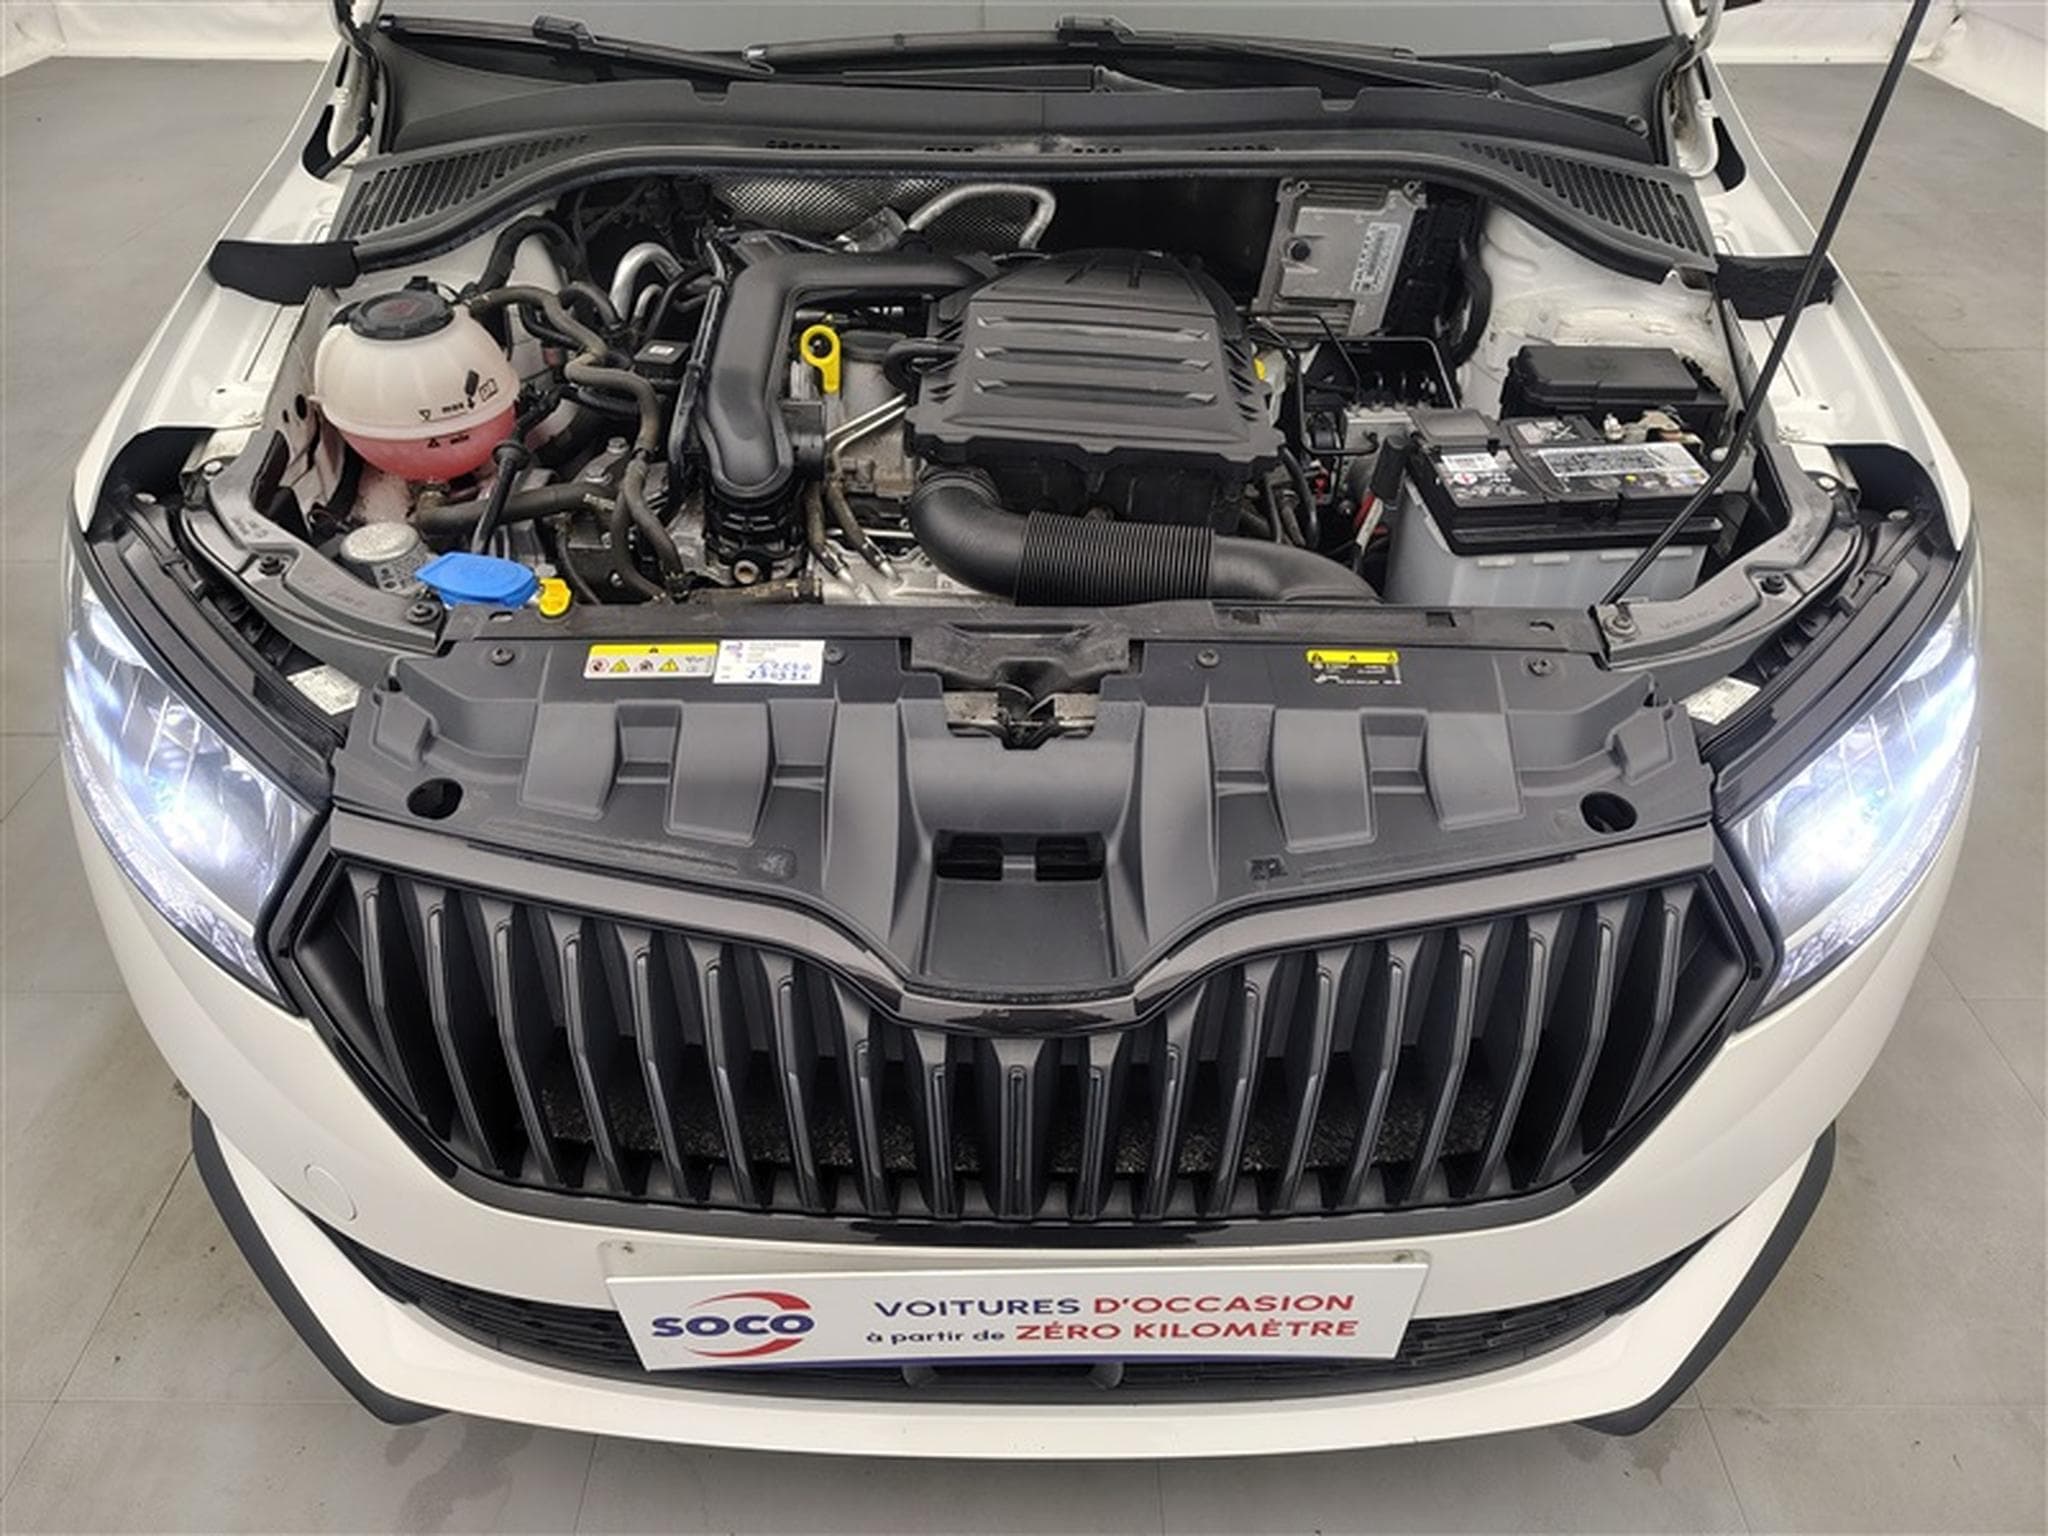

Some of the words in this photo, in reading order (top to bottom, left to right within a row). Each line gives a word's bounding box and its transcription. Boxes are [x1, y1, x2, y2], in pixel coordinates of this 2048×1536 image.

[875, 1298, 1081, 1317] VOITURES
[1094, 1294, 1355, 1314] D'OCCASION
[652, 1314, 815, 1337] SOCO
[866, 1329, 883, 1343] à
[890, 1329, 965, 1345] partir
[972, 1329, 1005, 1342] de
[1016, 1320, 1121, 1340] ZÉRO
[1133, 1318, 1360, 1339] KILOMÈTRE
